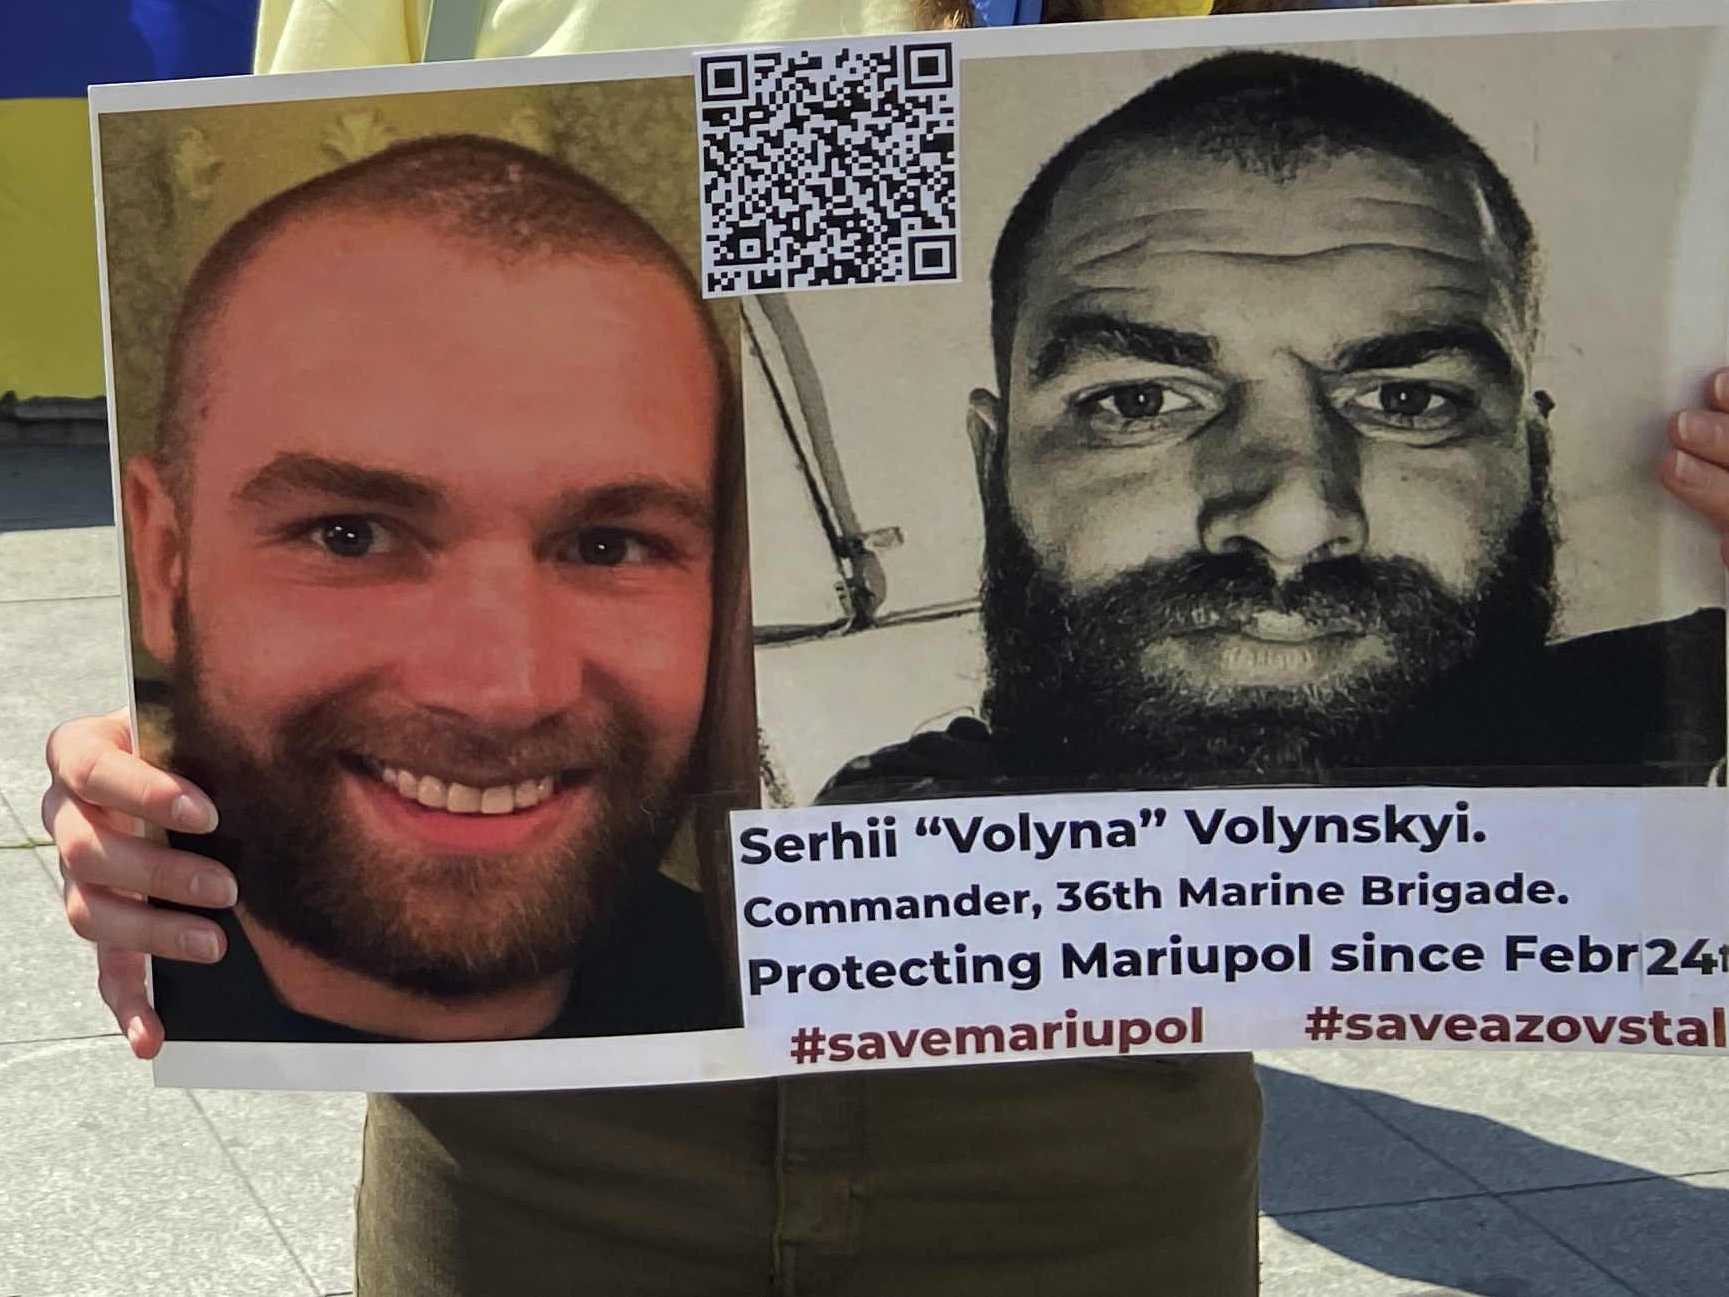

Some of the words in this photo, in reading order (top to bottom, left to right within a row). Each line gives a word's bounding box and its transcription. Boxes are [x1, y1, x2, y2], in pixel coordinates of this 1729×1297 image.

[739, 815, 898, 865] Serhii
[914, 807, 1167, 860] “Volyna”
[1183, 800, 1487, 853] Volynskyi.
[743, 884, 1042, 928] Commander,
[1056, 877, 1162, 913] 36th
[1179, 871, 1345, 909] Marine
[1361, 871, 1570, 914] Brigade.
[748, 943, 1040, 996] Protecting
[1061, 933, 1311, 983] Mariupol
[1331, 931, 1485, 973] since
[1505, 934, 1639, 973] Febr
[790, 1005, 1204, 1064] #savemariupol
[1304, 1005, 1728, 1049] #saveazovstal
